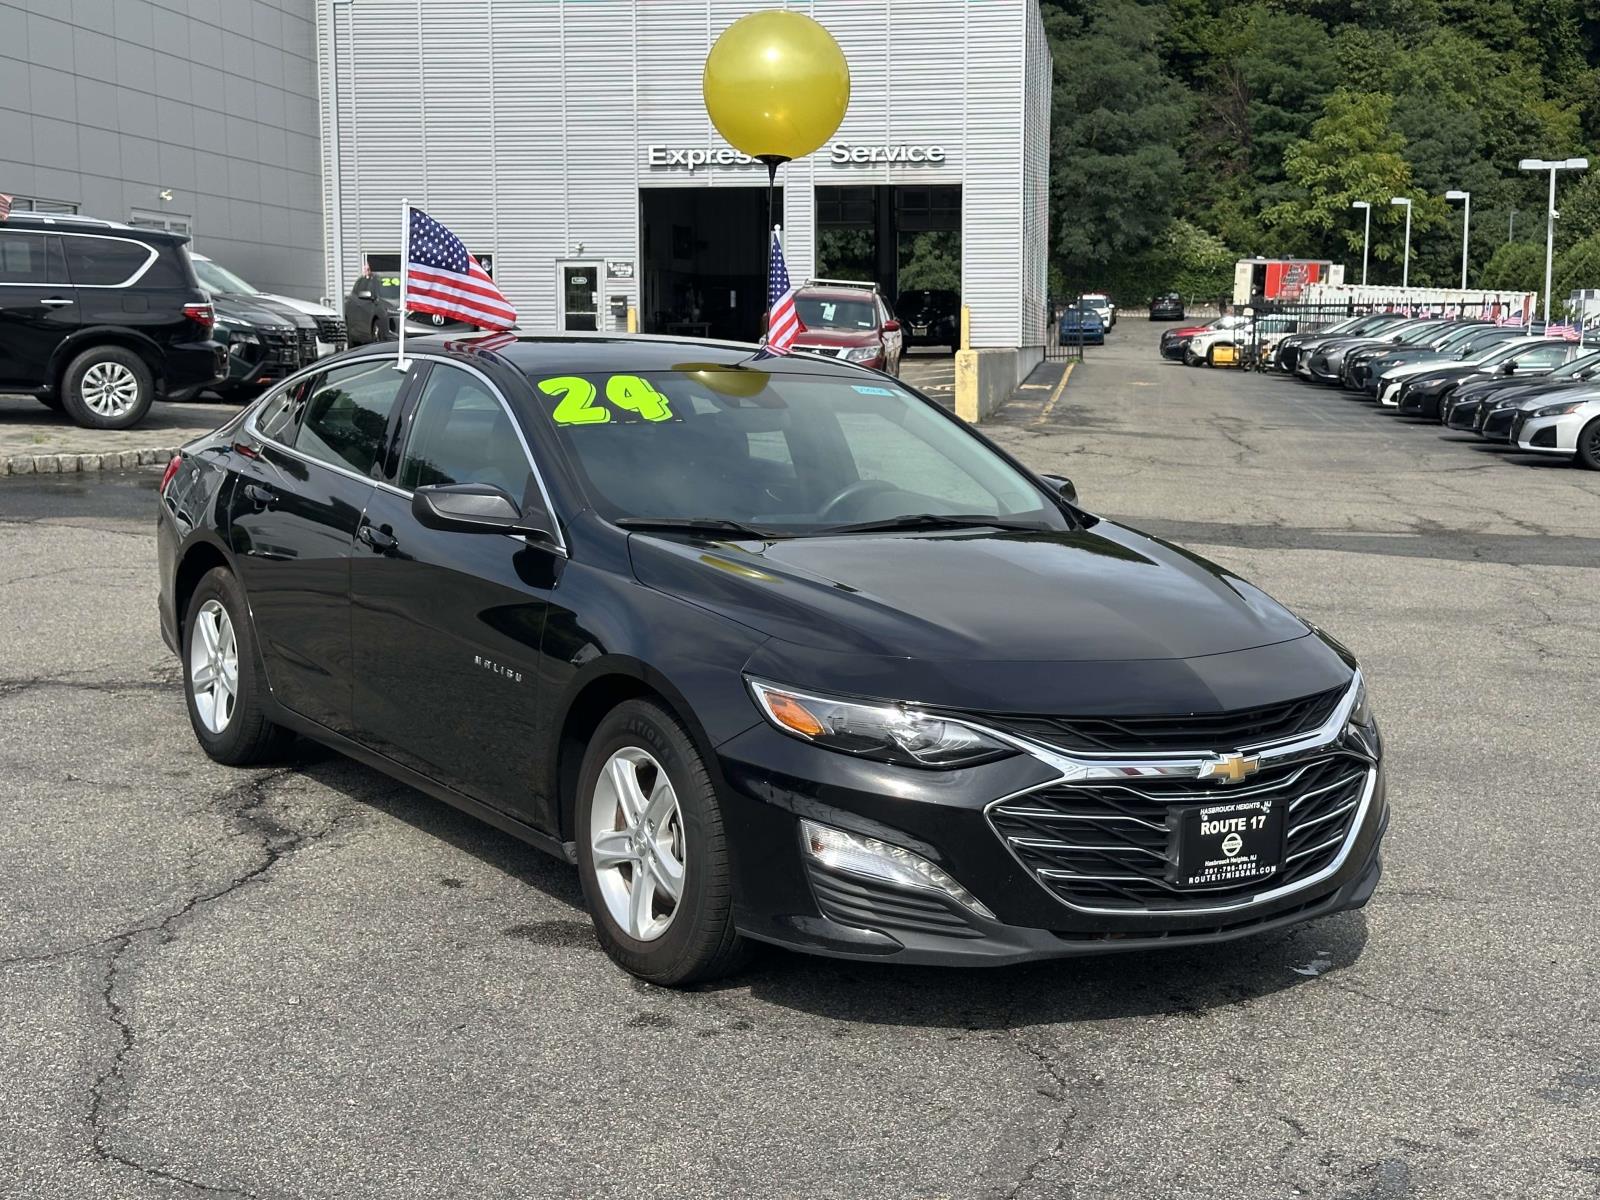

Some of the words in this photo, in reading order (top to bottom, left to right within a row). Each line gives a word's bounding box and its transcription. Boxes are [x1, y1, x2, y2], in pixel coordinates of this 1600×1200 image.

[649, 144, 765, 169] Expres
[830, 141, 945, 163] Service
[537, 375, 673, 424] 24
[474, 655, 522, 683] MALIBU
[1200, 805, 1235, 815] HASBROUCK
[1263, 800, 1272, 808] NJ
[1201, 818, 1247, 835] ROUTE
[1250, 815, 1266, 829] 17
[1204, 857, 1229, 867] Hasbrouck
[1188, 865, 1277, 884] ROUTE17NISSAN.COM
